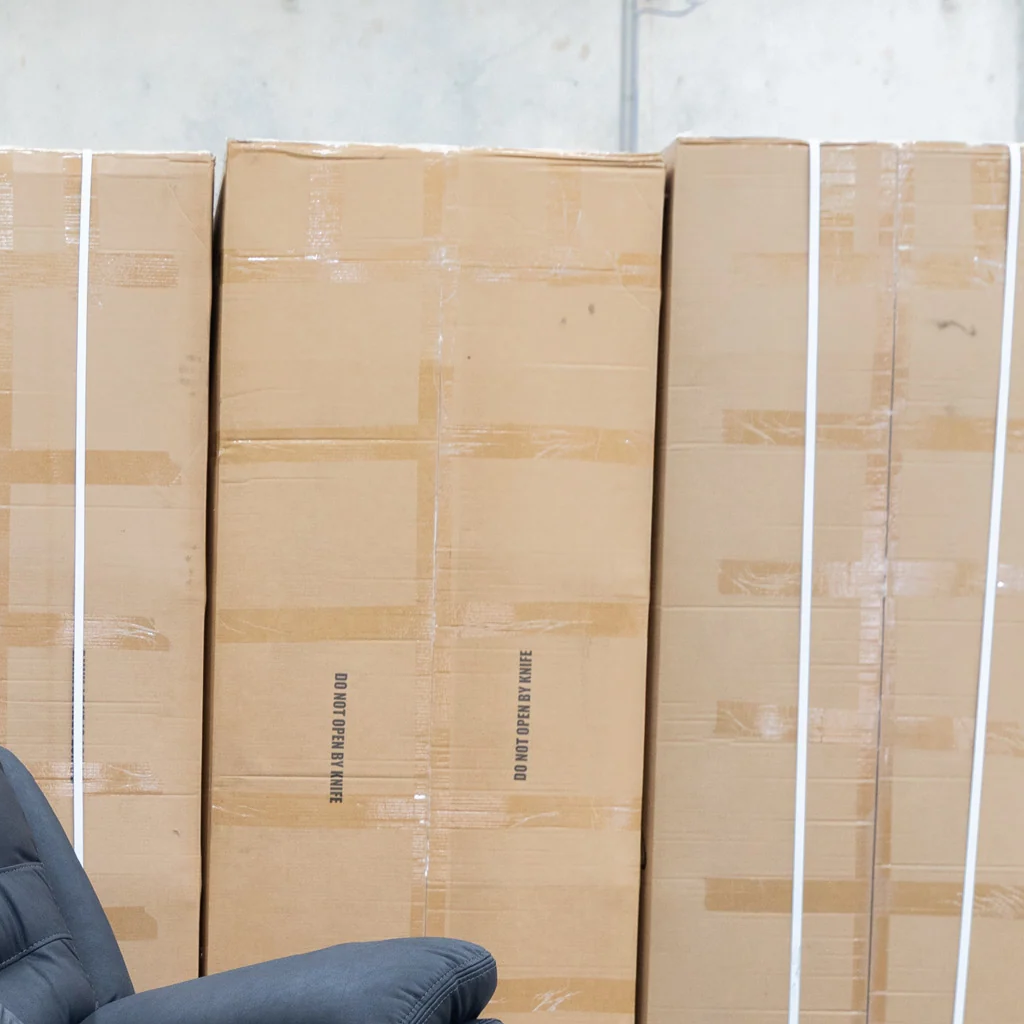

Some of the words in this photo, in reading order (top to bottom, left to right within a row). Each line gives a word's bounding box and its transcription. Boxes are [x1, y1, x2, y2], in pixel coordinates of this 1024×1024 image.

[519, 650, 533, 683] KNIFE
[334, 673, 348, 689] DO
[333, 692, 347, 717] NOT
[518, 686, 531, 702] BY
[516, 705, 531, 735] OPEN
[331, 719, 346, 749] OPEN
[331, 752, 344, 768] BY
[515, 737, 529, 761] NOT
[513, 764, 528, 780] DO
[329, 770, 344, 804] KNIFE
